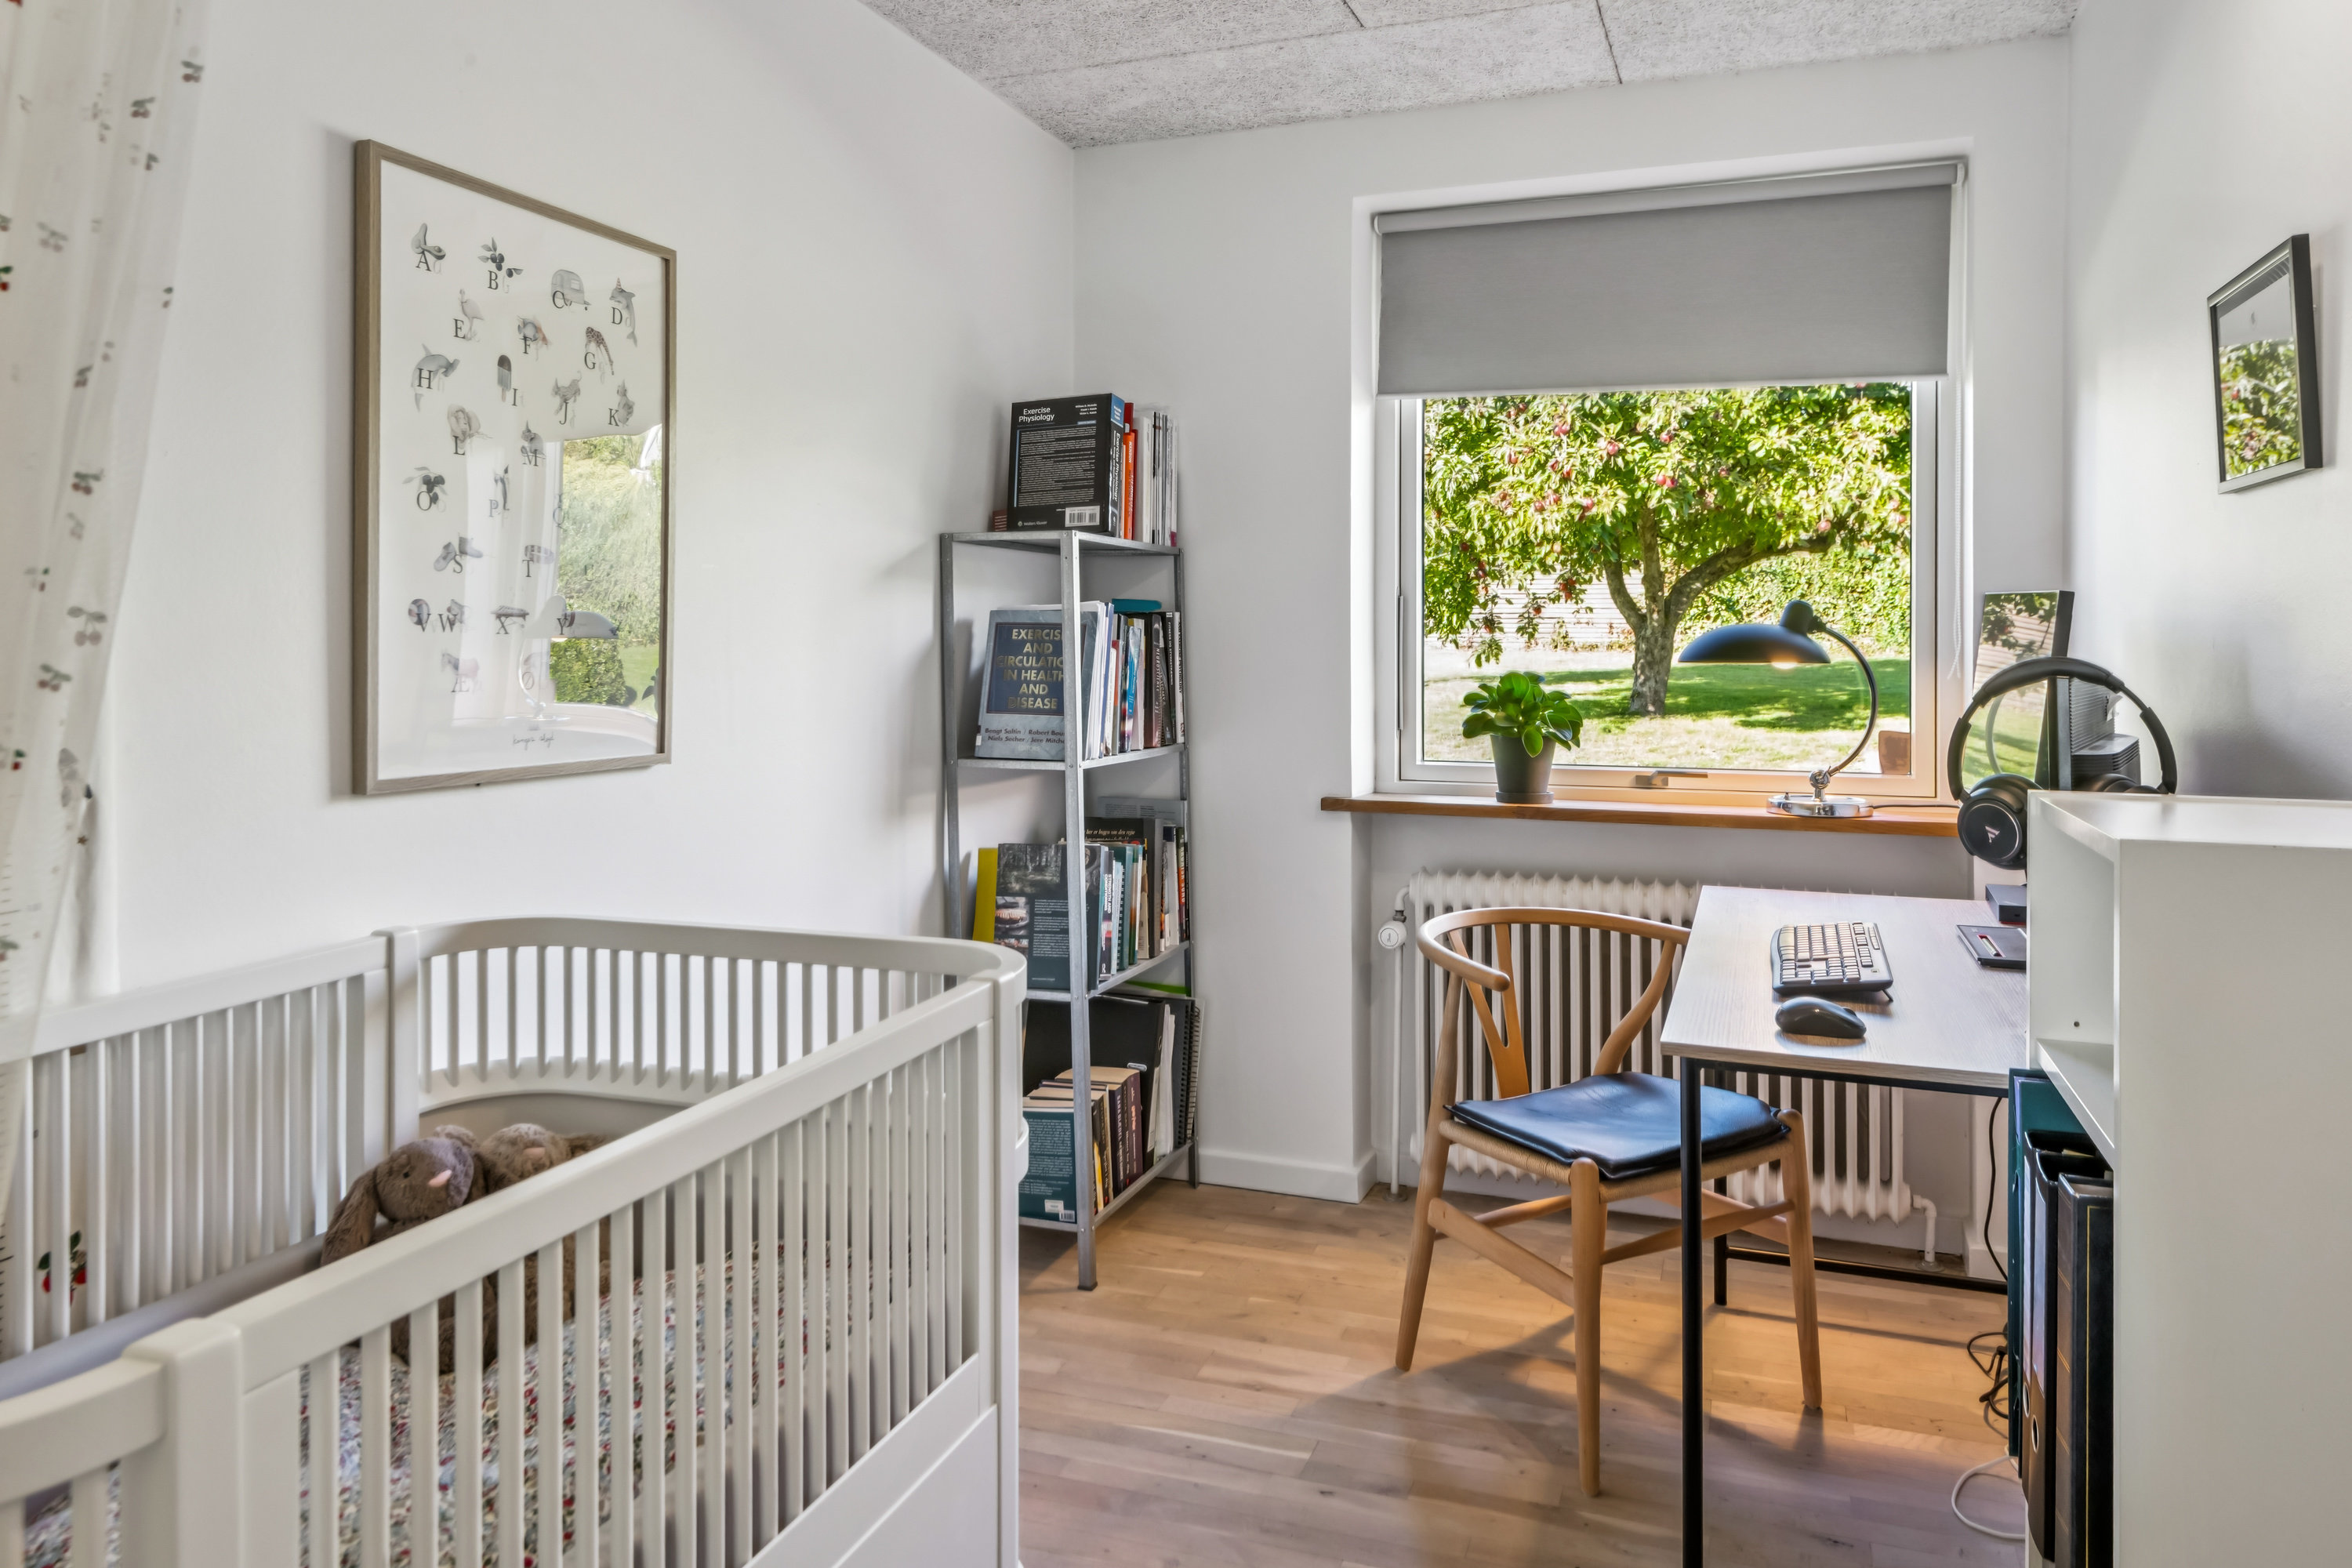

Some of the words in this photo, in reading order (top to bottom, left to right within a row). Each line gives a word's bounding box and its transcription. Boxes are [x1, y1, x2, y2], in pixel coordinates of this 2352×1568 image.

[416, 251, 432, 272] A
[487, 270, 499, 290] B
[552, 290, 565, 309] C
[611, 307, 623, 325] D
[452, 318, 466, 339] E
[521, 336, 532, 354] F
[584, 352, 596, 370] G
[416, 367, 434, 390] H
[511, 387, 518, 407] I
[559, 401, 569, 426] J
[608, 408, 619, 427] K
[1018, 413, 1055, 423] Physiology
[1023, 406, 1051, 416] Exercise
[452, 435, 466, 456] L
[522, 448, 539, 466] M
[416, 490, 432, 511] O
[488, 499, 499, 518] P
[452, 554, 463, 574] S
[521, 559, 535, 578] T
[416, 613, 432, 633] V
[437, 613, 459, 633] W
[495, 615, 510, 635] X
[1011, 629, 1062, 641] EXERCIS
[1022, 642, 1053, 654] AND
[996, 655, 1064, 667] CIRCULATIO
[1004, 669, 1018, 681] IN
[1019, 683, 1049, 695] AND
[1007, 696, 1058, 710] DISEASE
